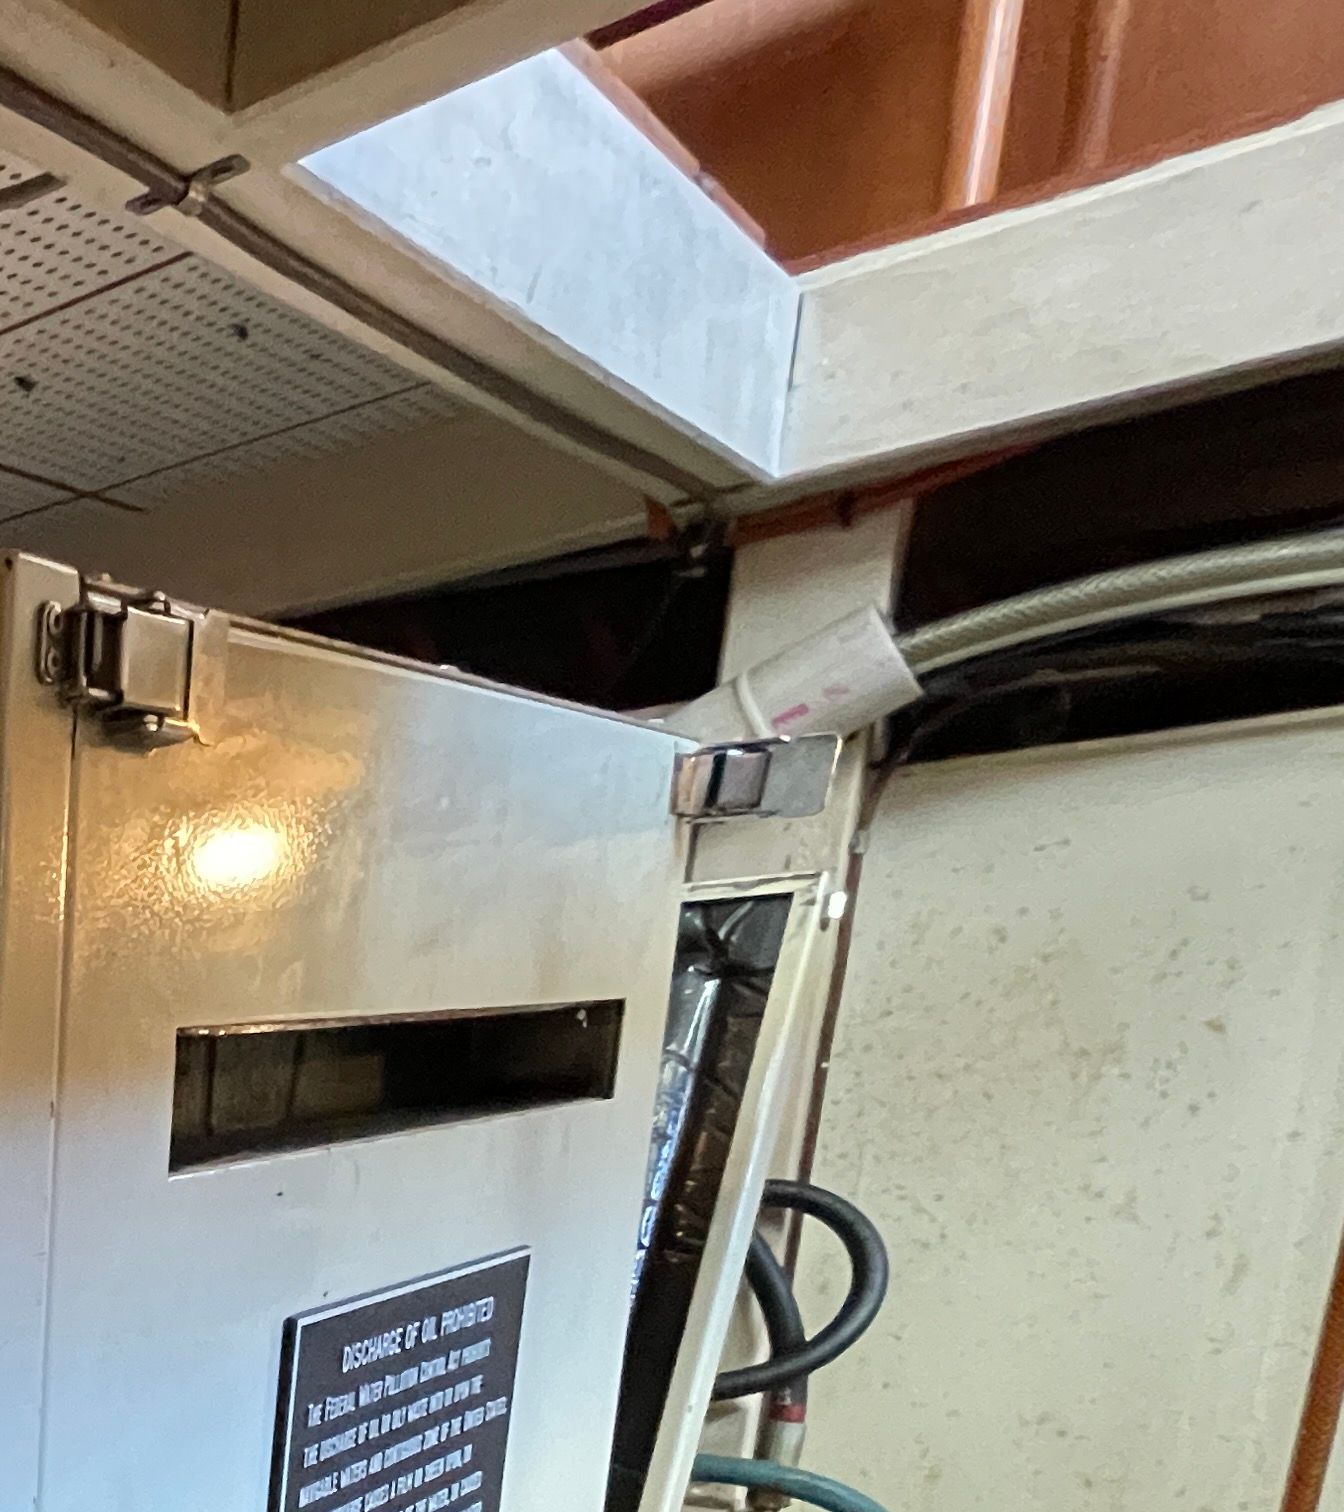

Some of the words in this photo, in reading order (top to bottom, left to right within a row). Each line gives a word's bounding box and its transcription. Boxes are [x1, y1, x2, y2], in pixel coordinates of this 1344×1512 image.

[342, 1327, 403, 1373] DISCHARGE
[404, 1321, 420, 1349] OF
[421, 1316, 437, 1343] OIL
